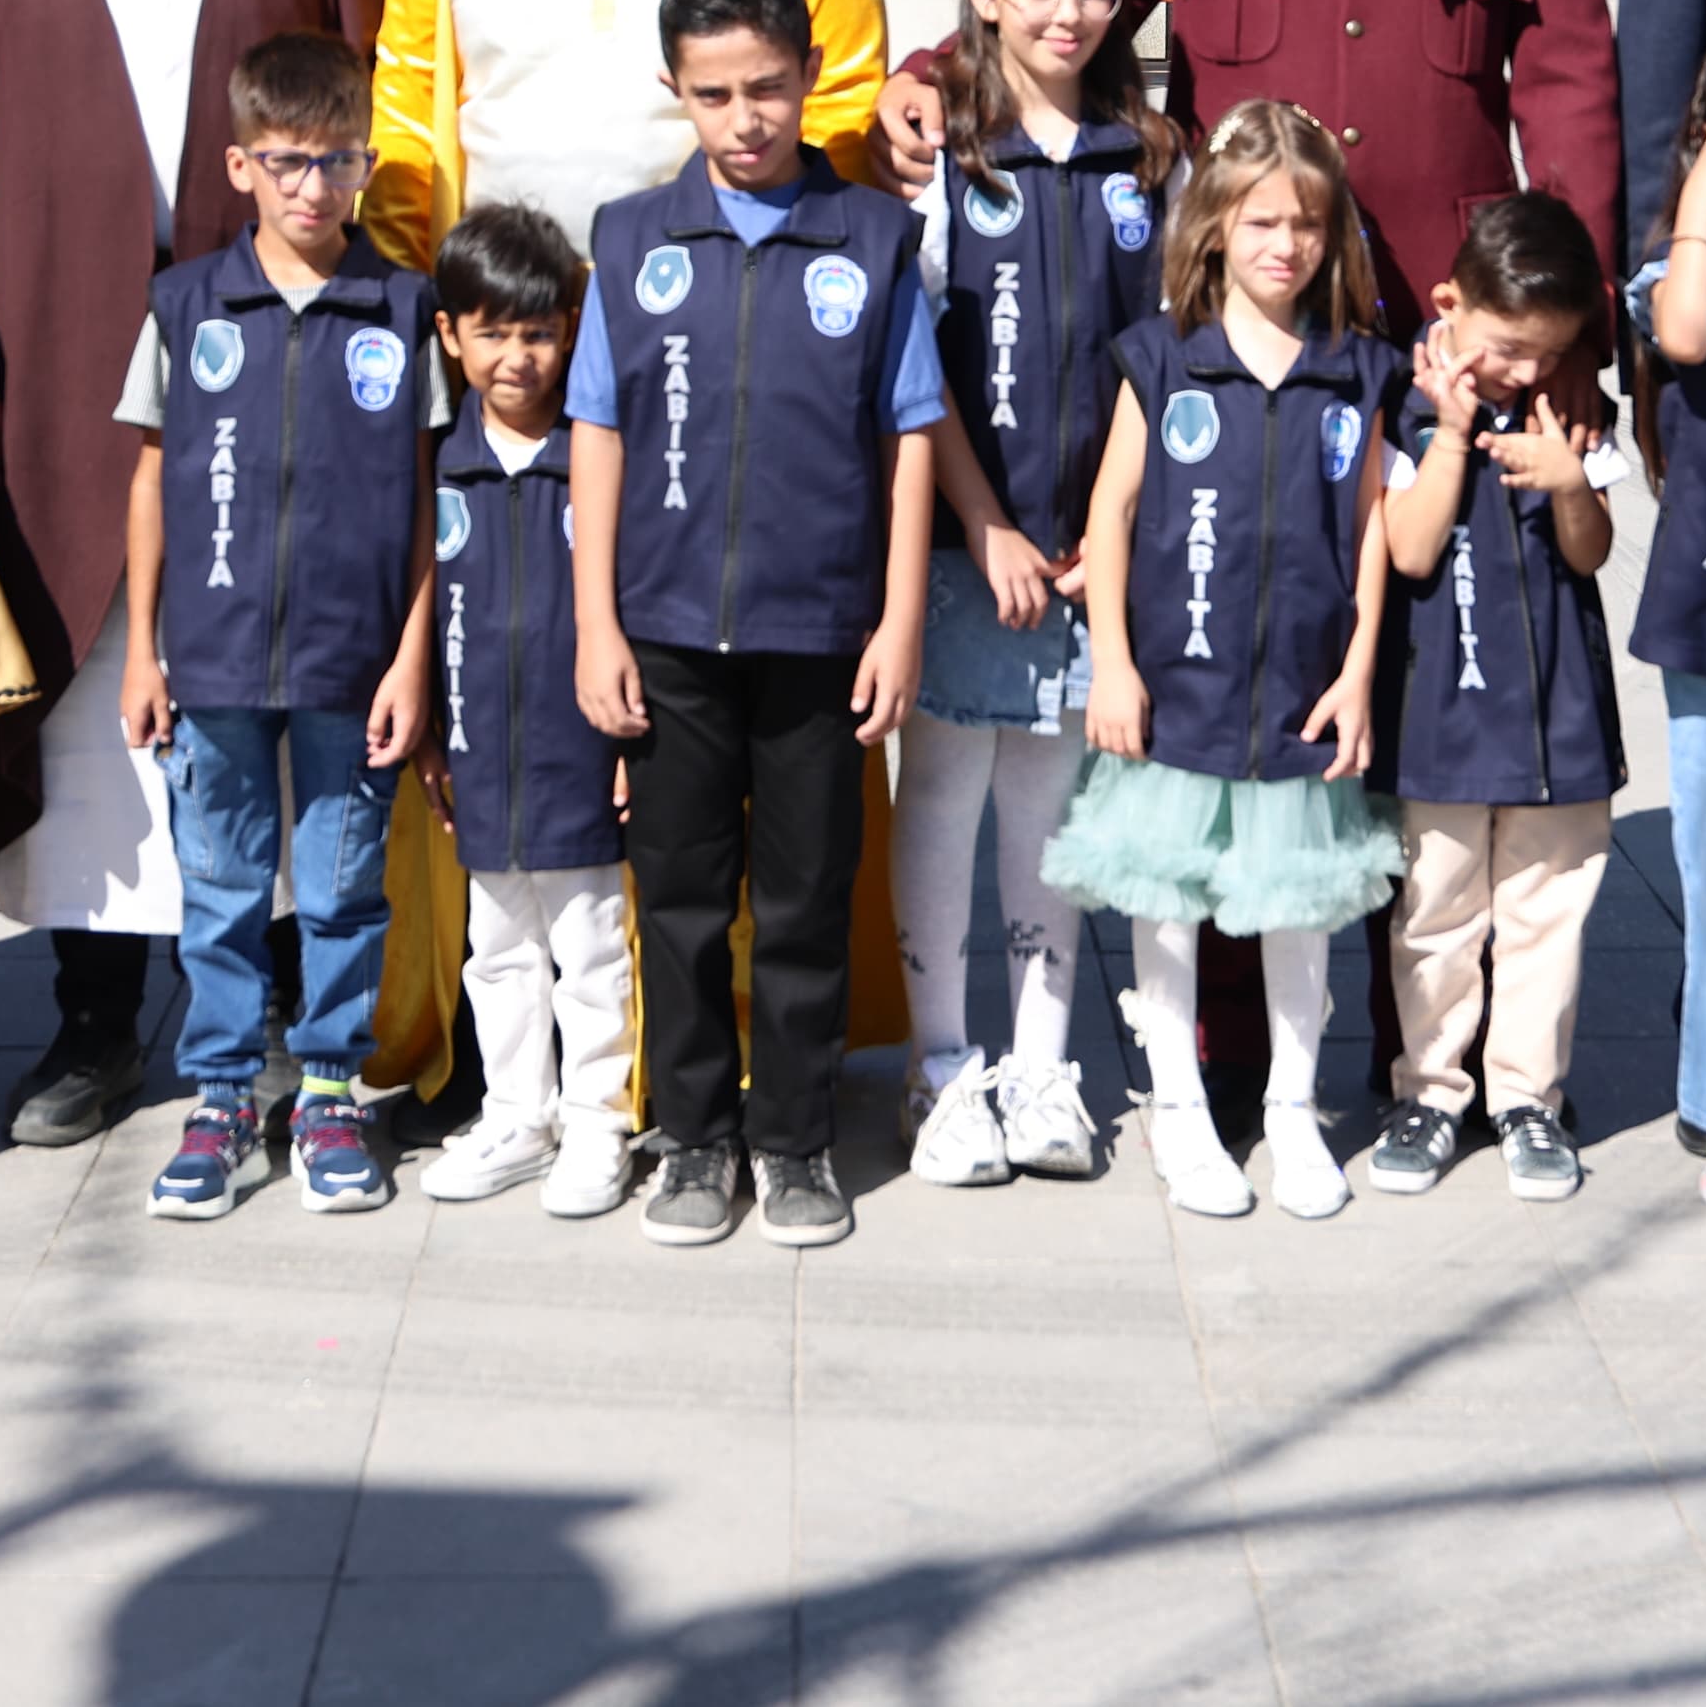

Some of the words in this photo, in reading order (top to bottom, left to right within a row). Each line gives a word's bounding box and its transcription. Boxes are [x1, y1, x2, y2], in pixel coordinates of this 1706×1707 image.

[663, 335, 691, 510] ZABITA
[990, 262, 1021, 429] ZABITA
[208, 417, 238, 588] ZABITA
[1183, 488, 1219, 659] ZABITA
[446, 583, 470, 752] ZABITA
[1451, 524, 1487, 690] ZABITA
